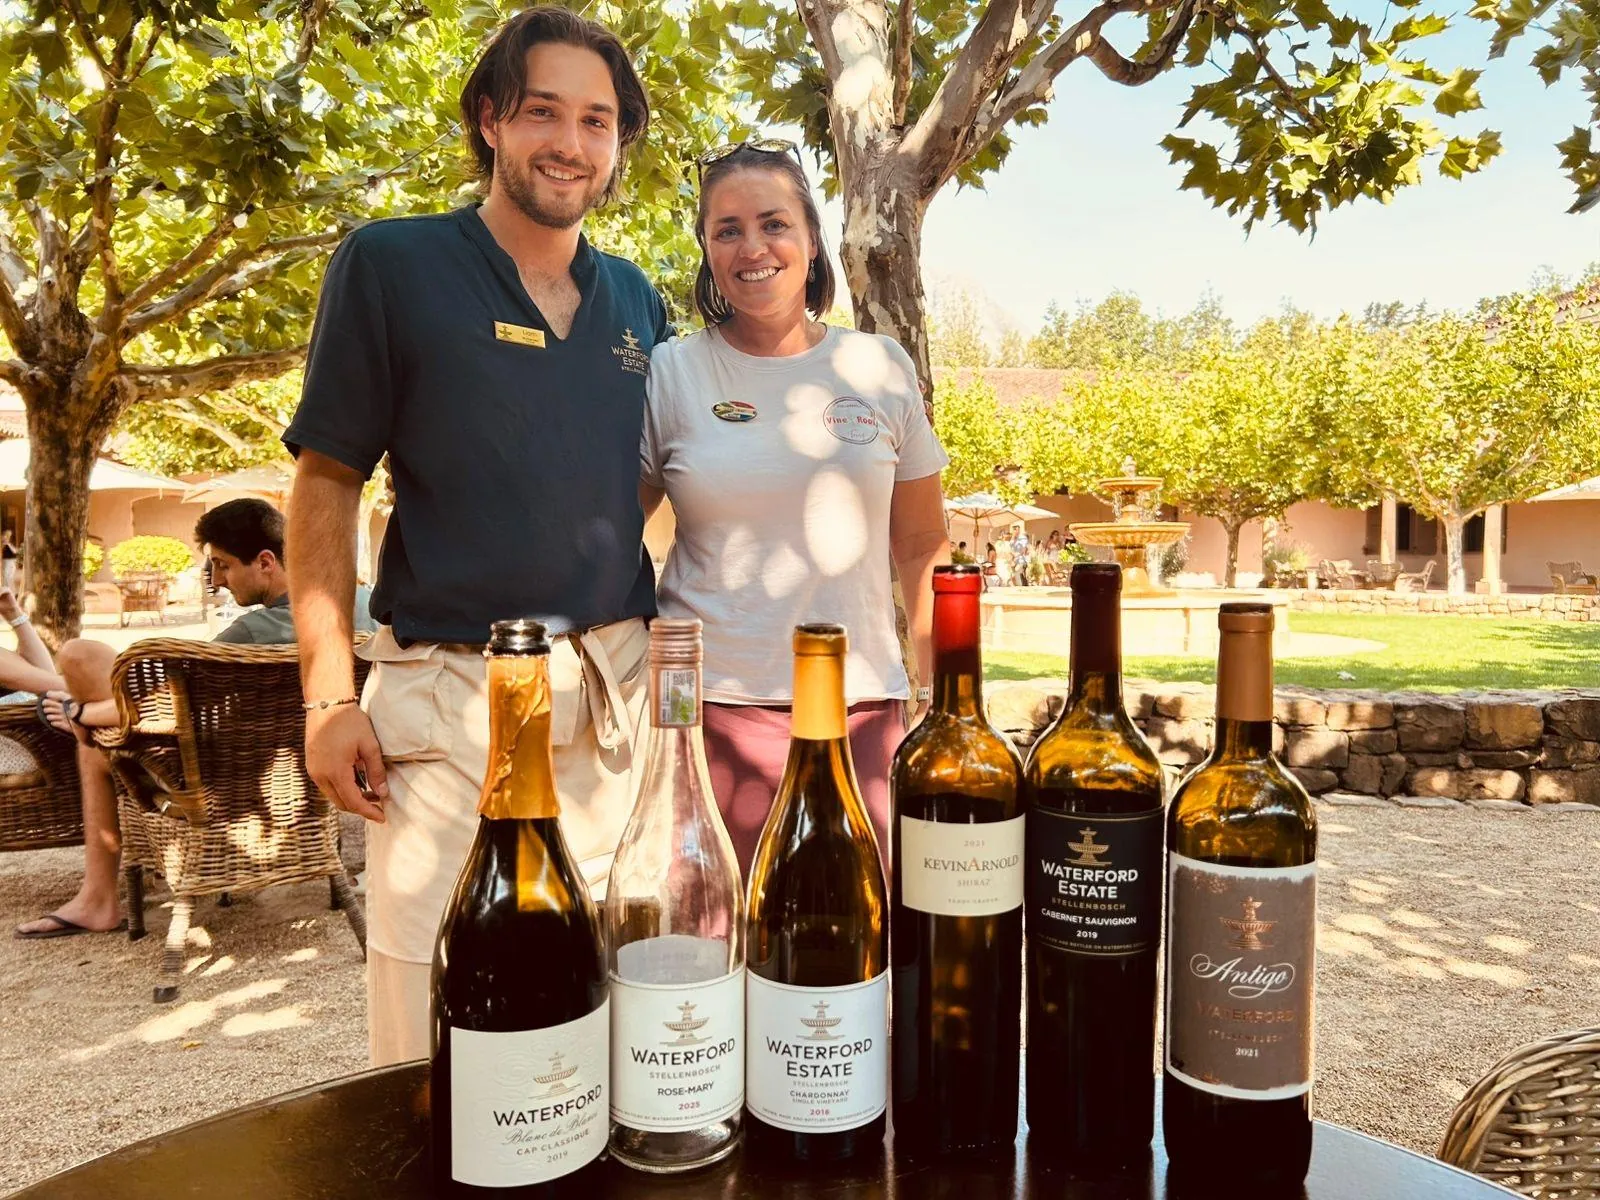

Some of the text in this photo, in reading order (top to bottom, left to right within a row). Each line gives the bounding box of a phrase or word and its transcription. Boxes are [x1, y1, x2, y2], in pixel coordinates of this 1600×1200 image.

[826, 415, 849, 424] Vine
[1041, 859, 1139, 883] WATERFORD
[957, 878, 991, 887] SHIRAZ
[1058, 880, 1118, 899] ESTATE
[1051, 896, 1126, 911] STELLENBOSCH
[1041, 907, 1137, 926] CABERNET SAUVIGNON
[1076, 930, 1098, 939] 2019
[1190, 953, 1296, 999] Antigo
[630, 1038, 736, 1066] WATERFORD
[766, 1036, 873, 1060] WATERFORD
[1235, 1047, 1259, 1058] 2021
[649, 1064, 721, 1080] STELLENBOSCH
[786, 1060, 853, 1078] ESTATE
[657, 1081, 715, 1096] ROSE-MARY
[789, 1089, 850, 1099] CHARDONNAY
[493, 1084, 602, 1127] WATERFORD
[501, 1126, 548, 1145] Blanc
[516, 1128, 590, 1156] CAP CLASSIQUE
[546, 1151, 569, 1164] 2019
